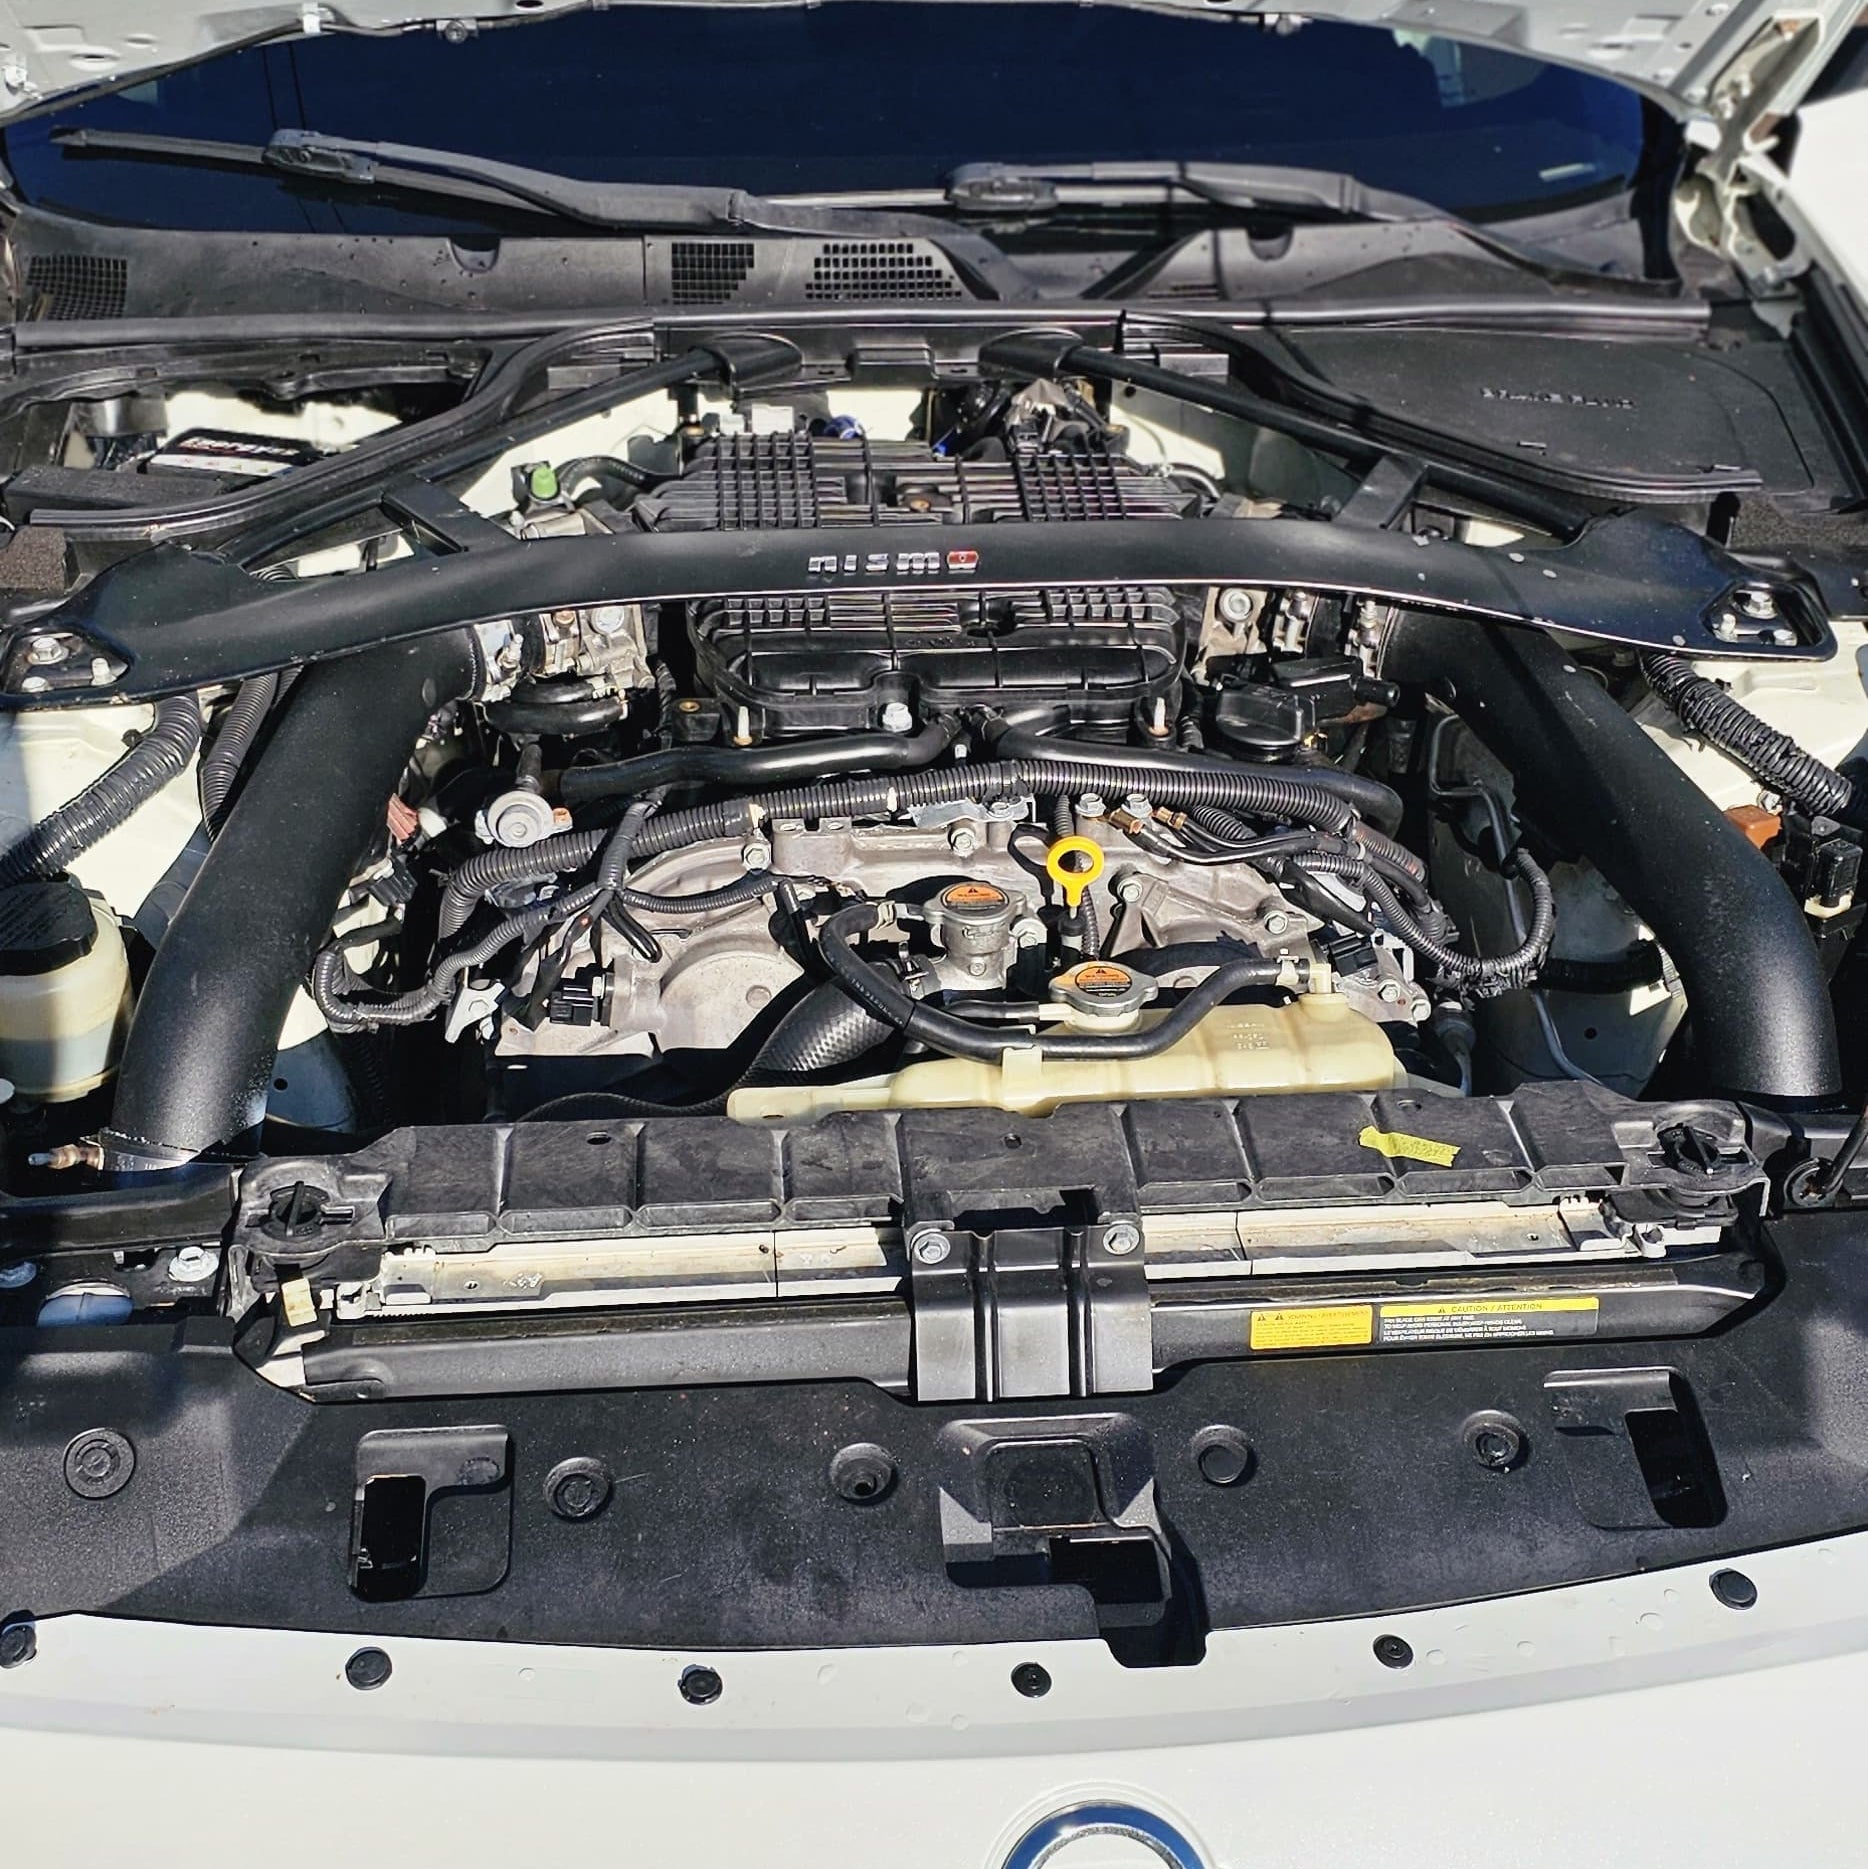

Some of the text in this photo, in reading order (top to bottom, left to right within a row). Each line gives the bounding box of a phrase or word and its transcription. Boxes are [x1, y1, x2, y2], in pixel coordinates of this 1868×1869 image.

[807, 551, 979, 573] nismo
[1450, 1305, 1488, 1313] CAUTION
[1497, 1302, 1543, 1311] ATTENTION
